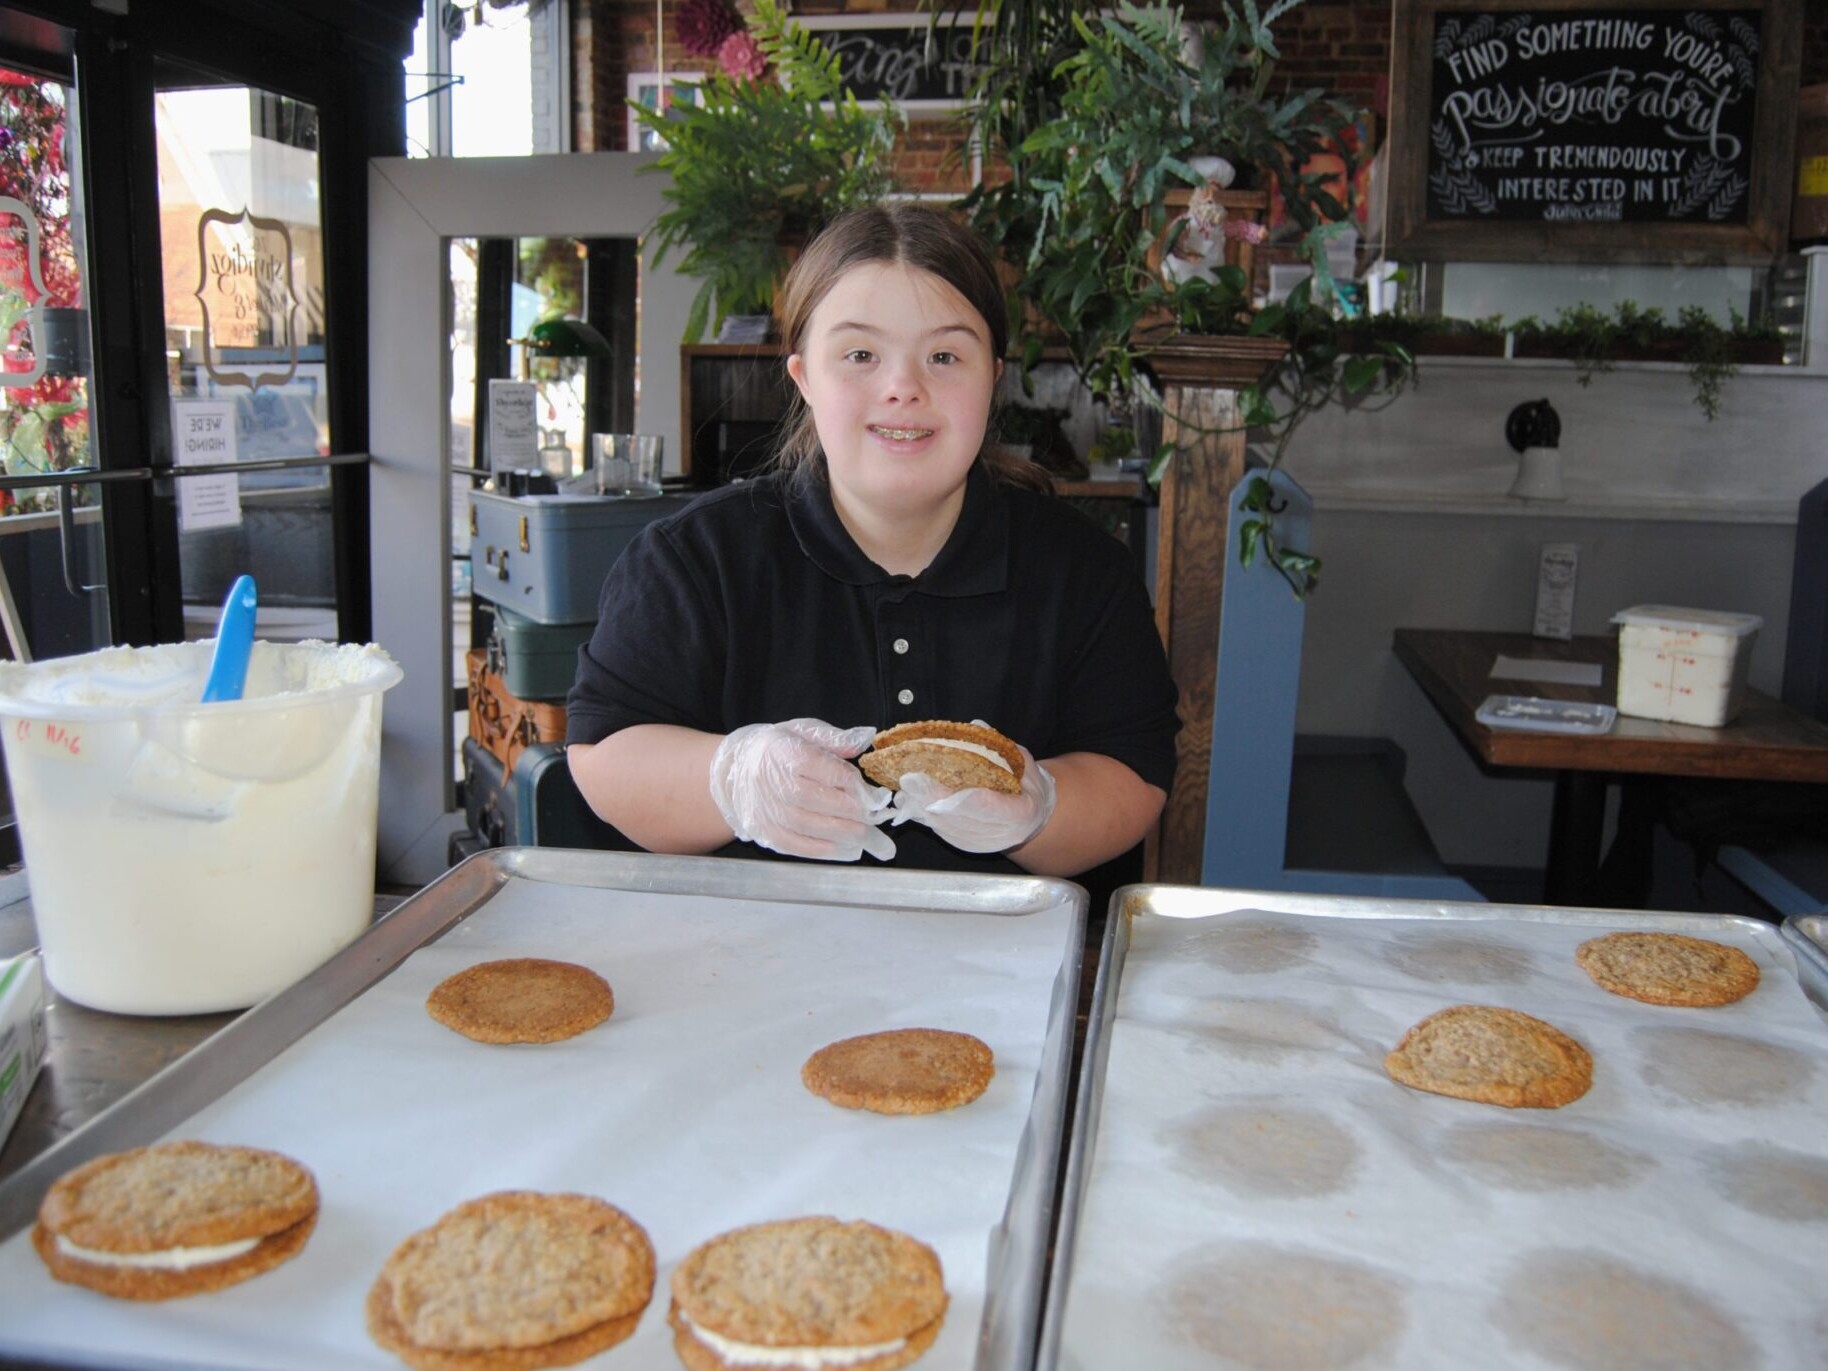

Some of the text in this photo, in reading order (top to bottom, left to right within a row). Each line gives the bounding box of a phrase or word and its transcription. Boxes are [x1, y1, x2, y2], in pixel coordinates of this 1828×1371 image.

[1447, 19, 1732, 89] FIND SOMETHING YOU'RE
[1442, 66, 1741, 161] passionate about
[1482, 147, 1525, 167] KEEP
[1534, 145, 1687, 172] TREMENDOUSLY
[1499, 177, 1626, 202] INTERESTED
[1633, 178, 1654, 202] IN
